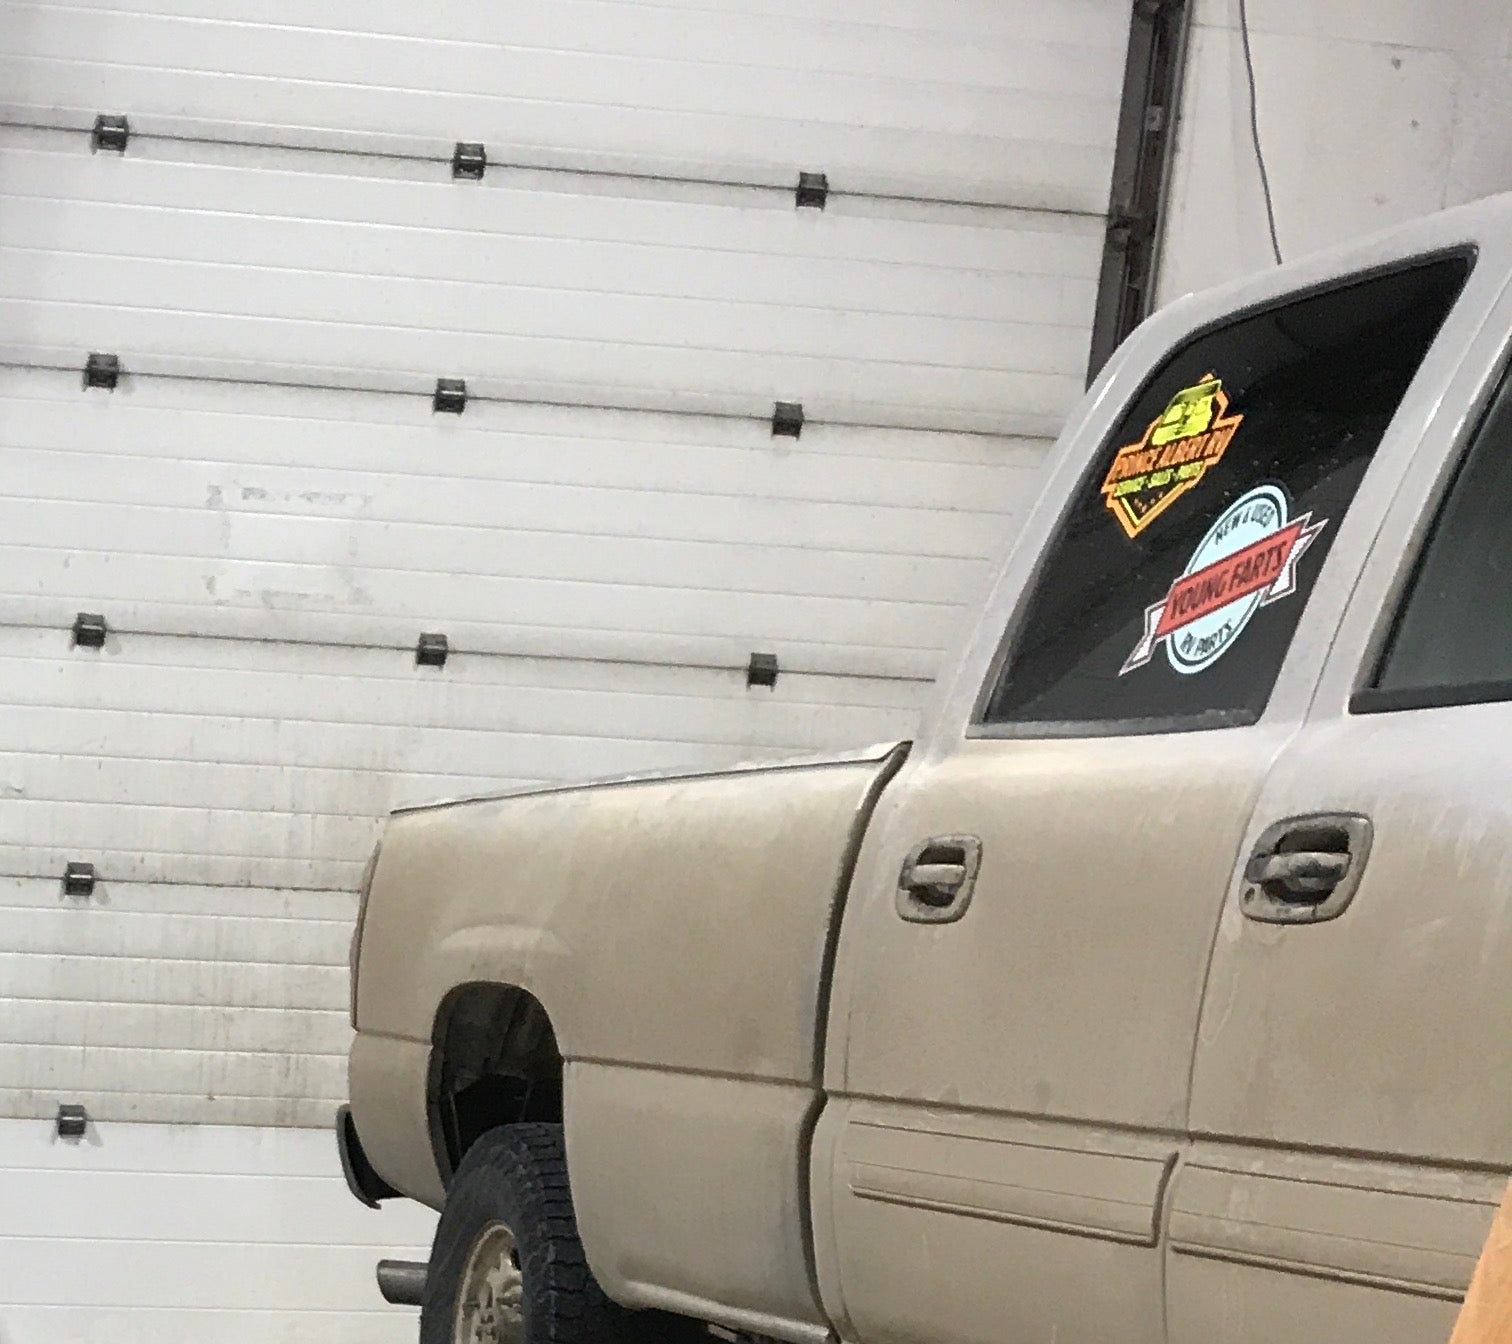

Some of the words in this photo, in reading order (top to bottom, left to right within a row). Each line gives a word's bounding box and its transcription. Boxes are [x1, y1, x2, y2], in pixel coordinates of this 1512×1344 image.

[1214, 513, 1242, 545] NEW
[1170, 569, 1228, 619] YOUNG
[1229, 541, 1287, 591] FARTS
[1194, 618, 1233, 656] PARTS
